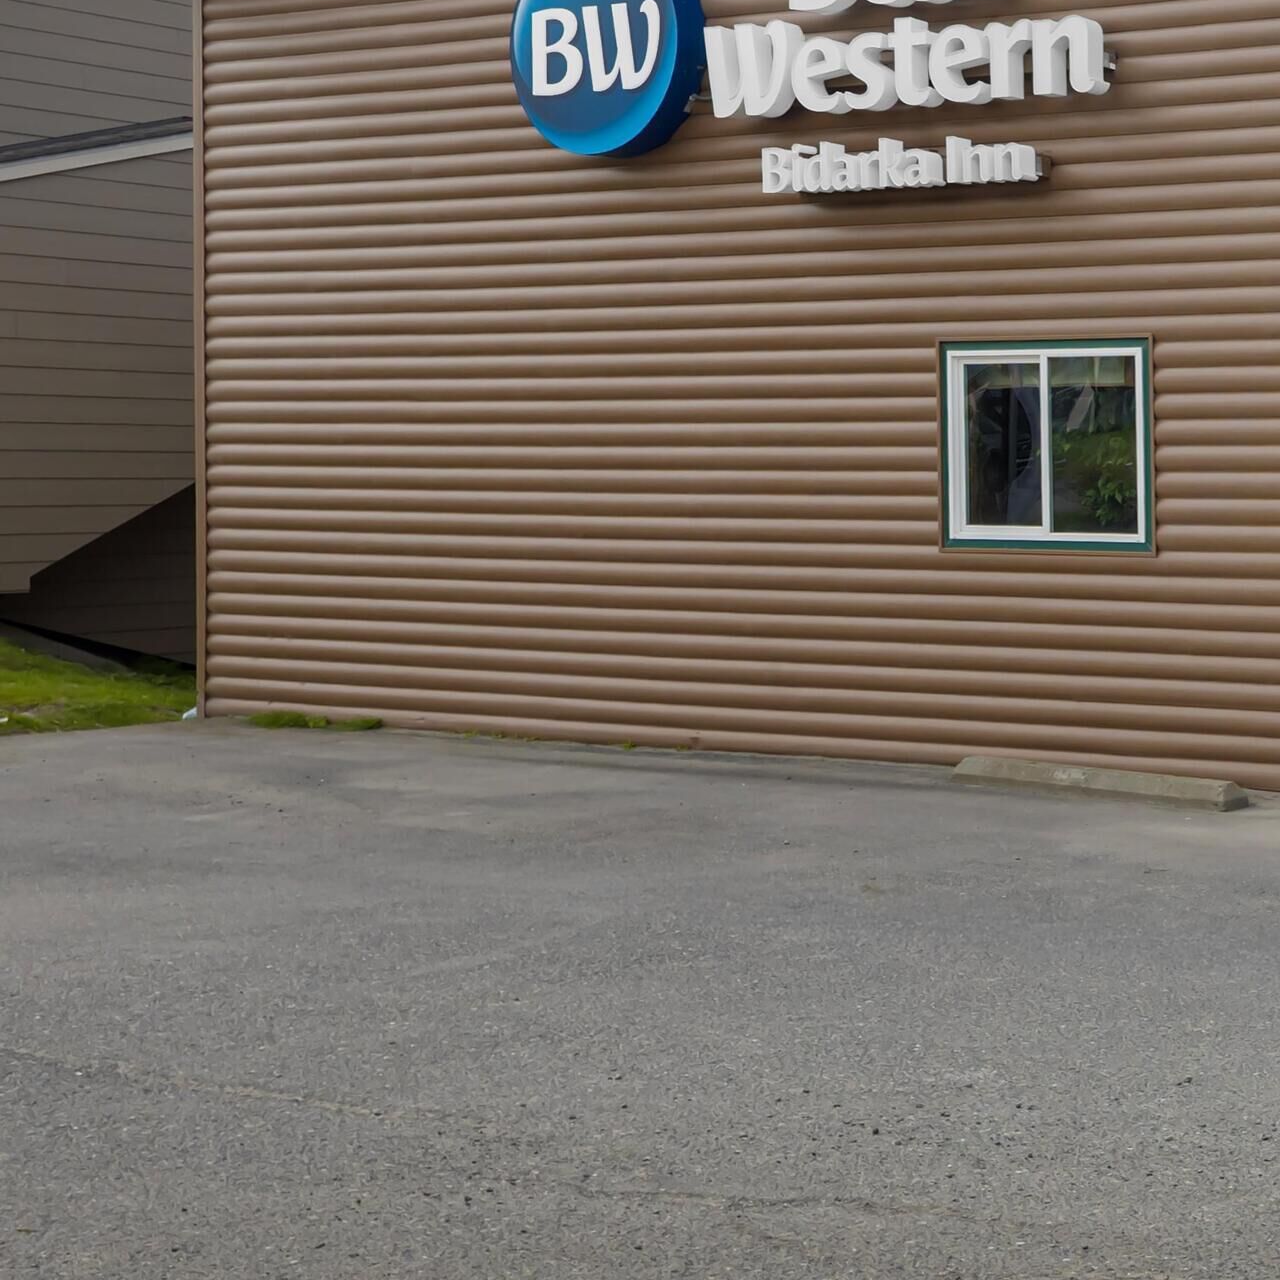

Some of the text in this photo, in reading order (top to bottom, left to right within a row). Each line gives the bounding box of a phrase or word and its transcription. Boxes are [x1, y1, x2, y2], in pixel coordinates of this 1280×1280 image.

[704, 15, 1112, 118] Western
[761, 135, 1039, 194] Bidarka Inn
